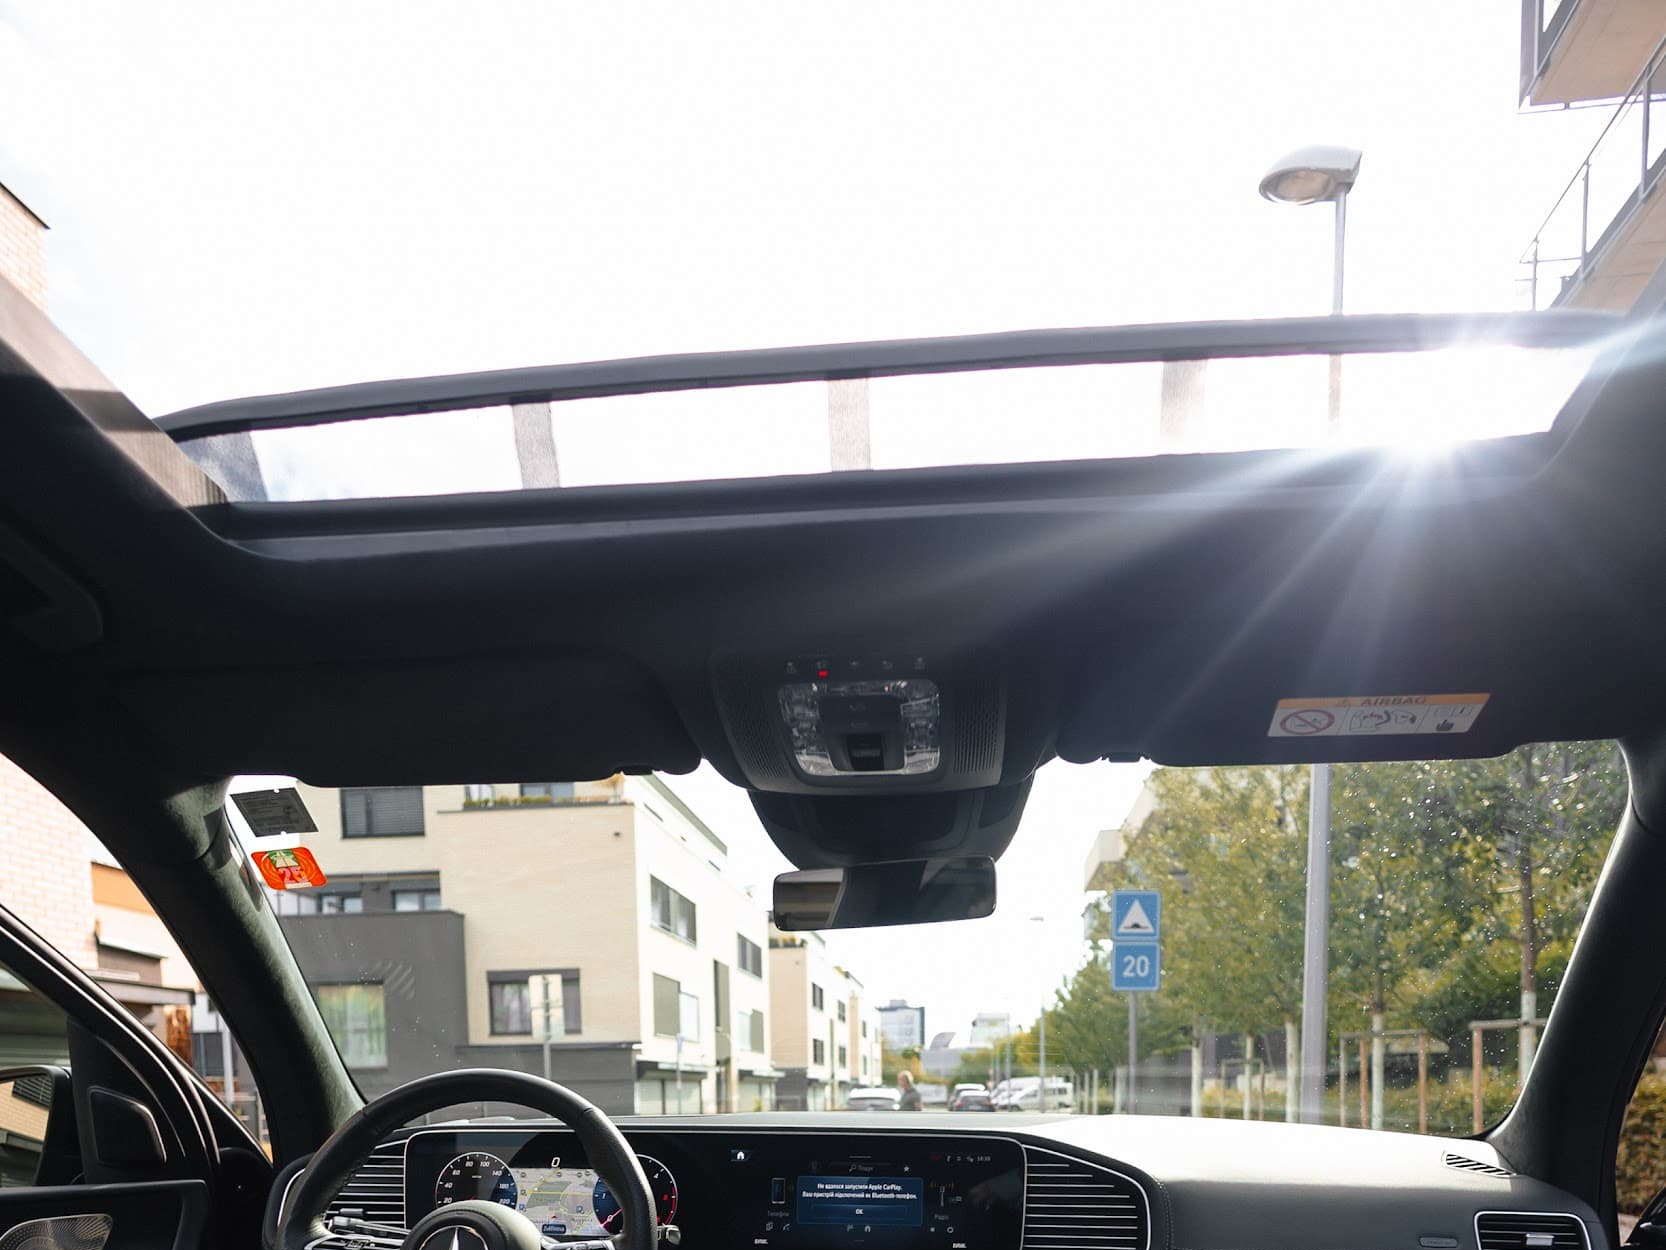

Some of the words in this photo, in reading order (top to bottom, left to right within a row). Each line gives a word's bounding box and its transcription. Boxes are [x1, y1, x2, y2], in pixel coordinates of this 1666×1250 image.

[1360, 696, 1427, 707] AIRBAG
[278, 867, 310, 884] 25
[1122, 955, 1150, 977] 20
[551, 1157, 560, 1168] 0
